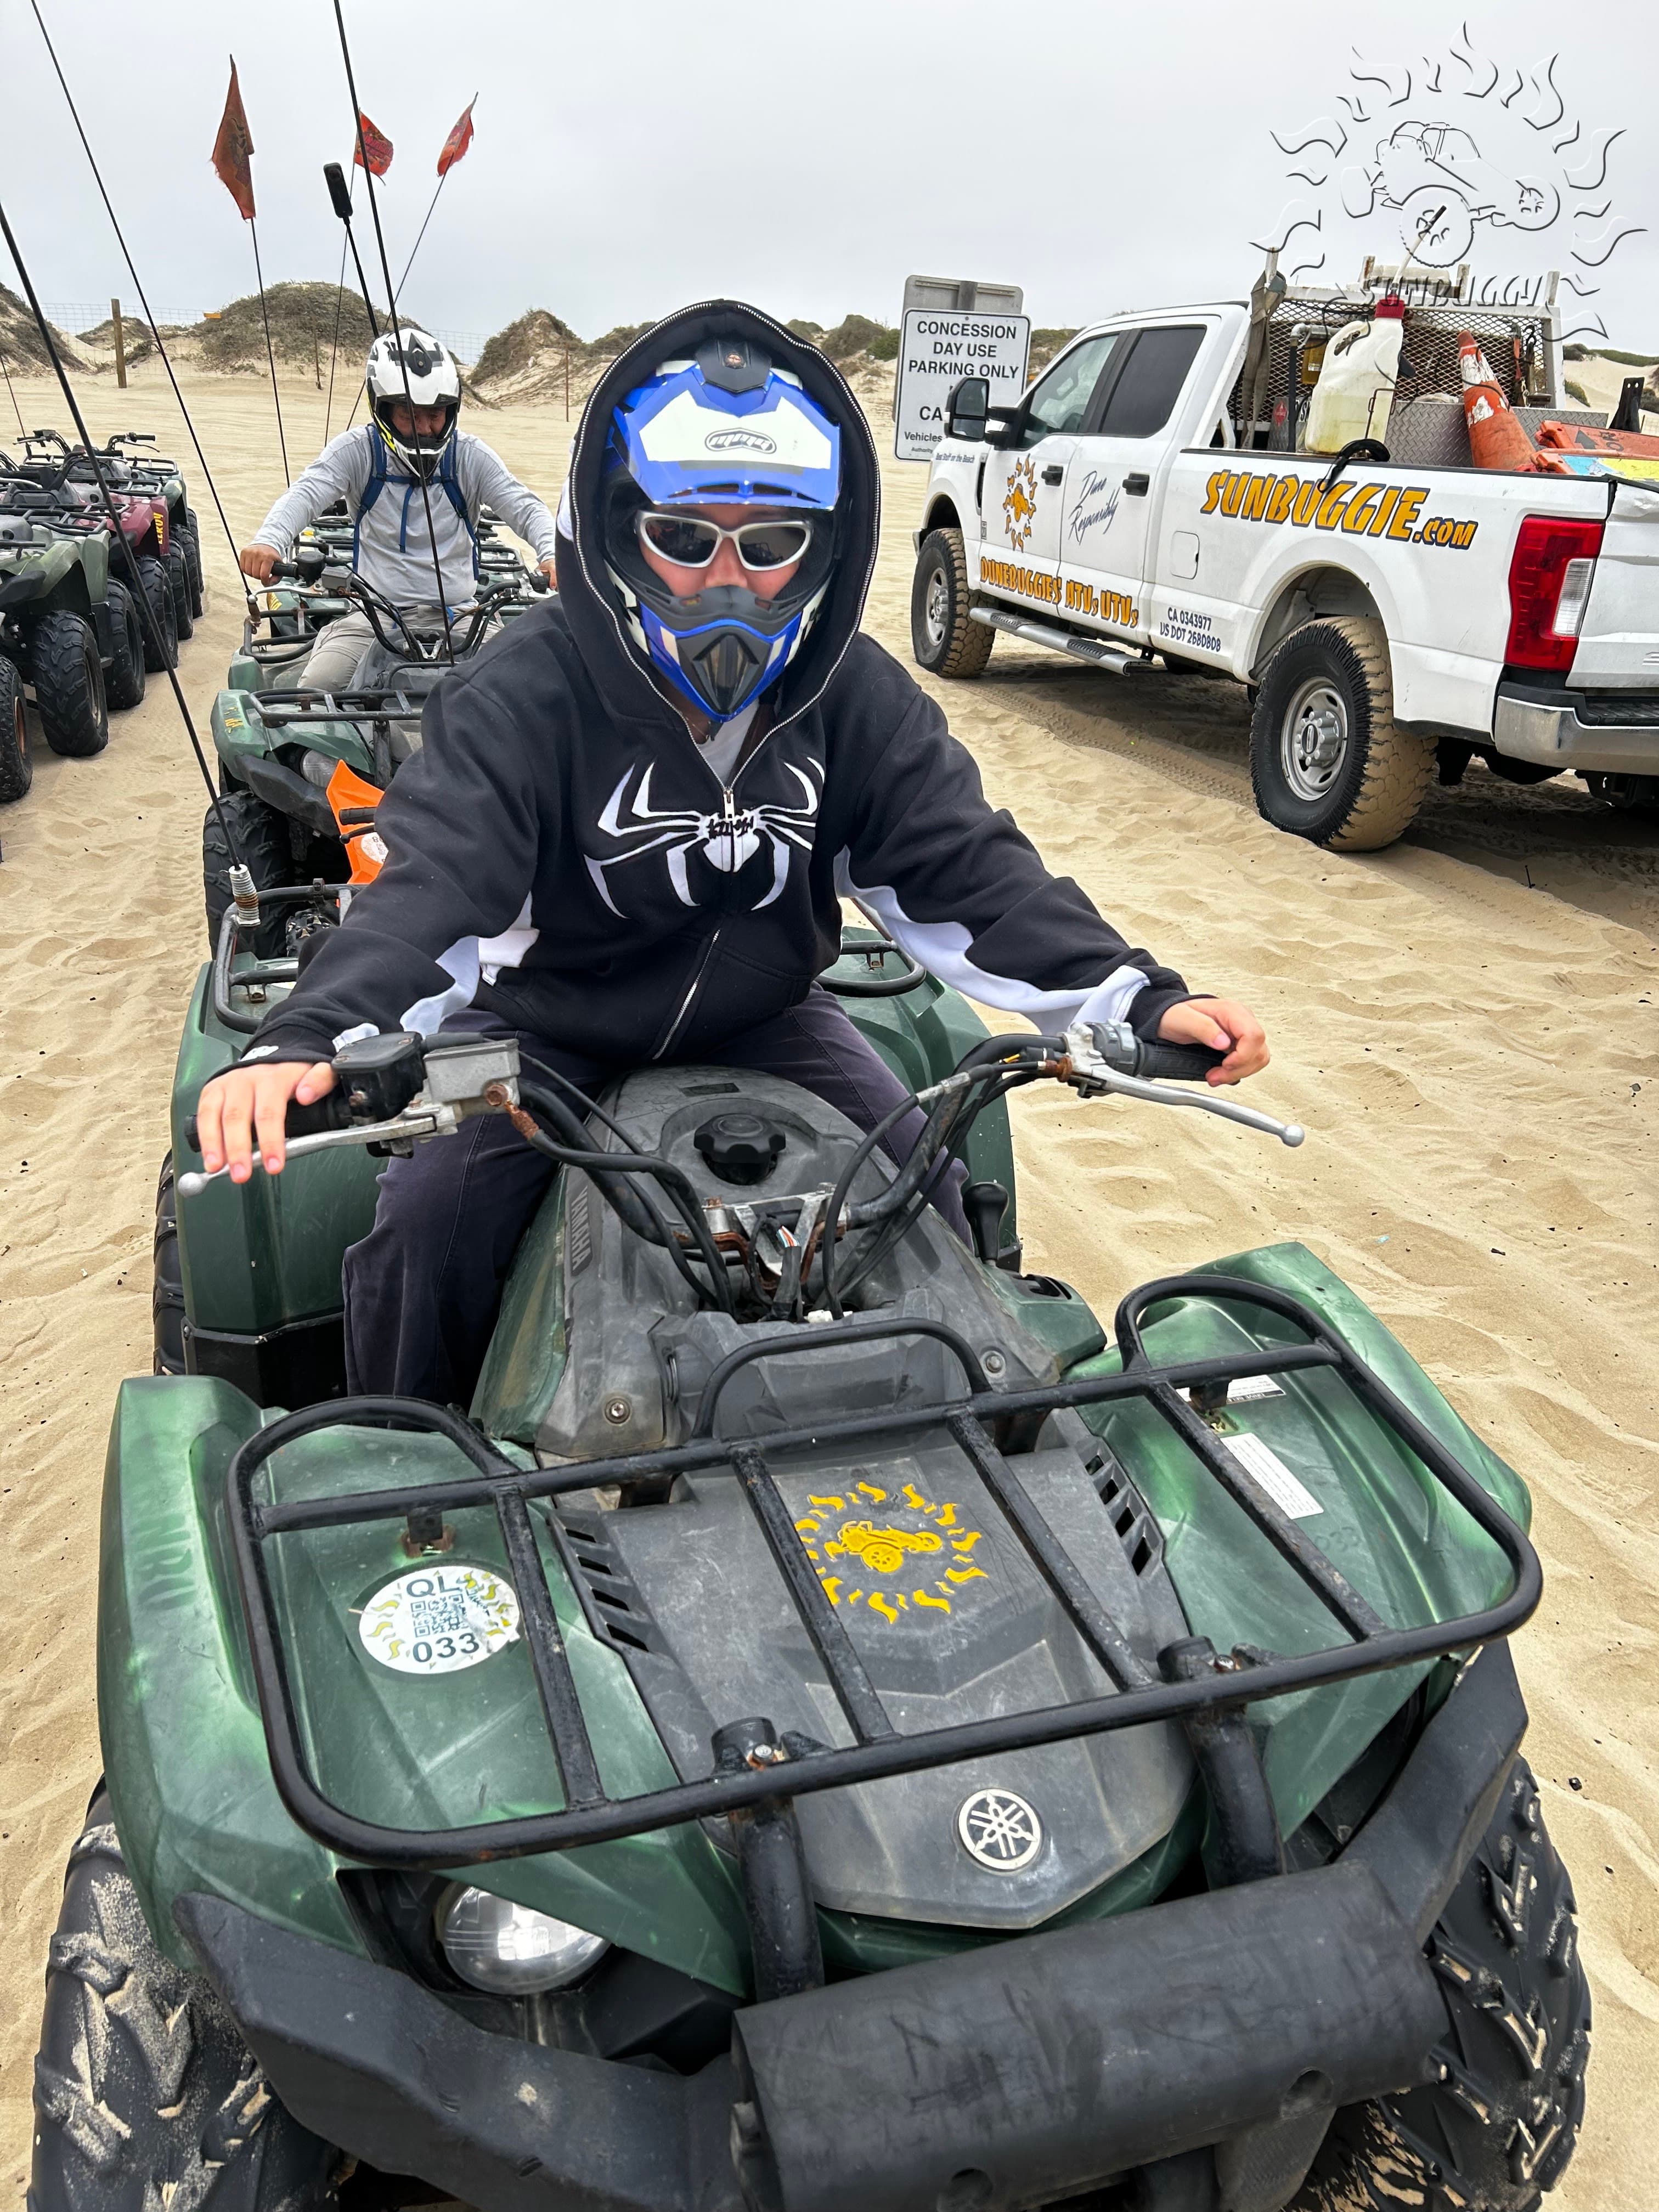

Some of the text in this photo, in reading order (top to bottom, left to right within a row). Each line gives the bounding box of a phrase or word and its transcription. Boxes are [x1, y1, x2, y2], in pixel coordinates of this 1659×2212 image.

[917, 321, 1016, 339] CONCESSION
[933, 341, 997, 358] DAY USE
[909, 360, 1019, 379] PARKING ONLY
[904, 431, 943, 442] Vehicles
[1076, 470, 1107, 508] Dune
[1068, 486, 1120, 546] Responsibly
[980, 556, 1139, 629] DUNEBUGGIES ATVs UTVs
[1167, 607, 1211, 631] CA 0343977
[1160, 622, 1221, 652] US DOT 2680808
[571, 1185, 591, 1271] YAMAHA
[406, 1576, 462, 1598] QL
[413, 1633, 479, 1663] 033
